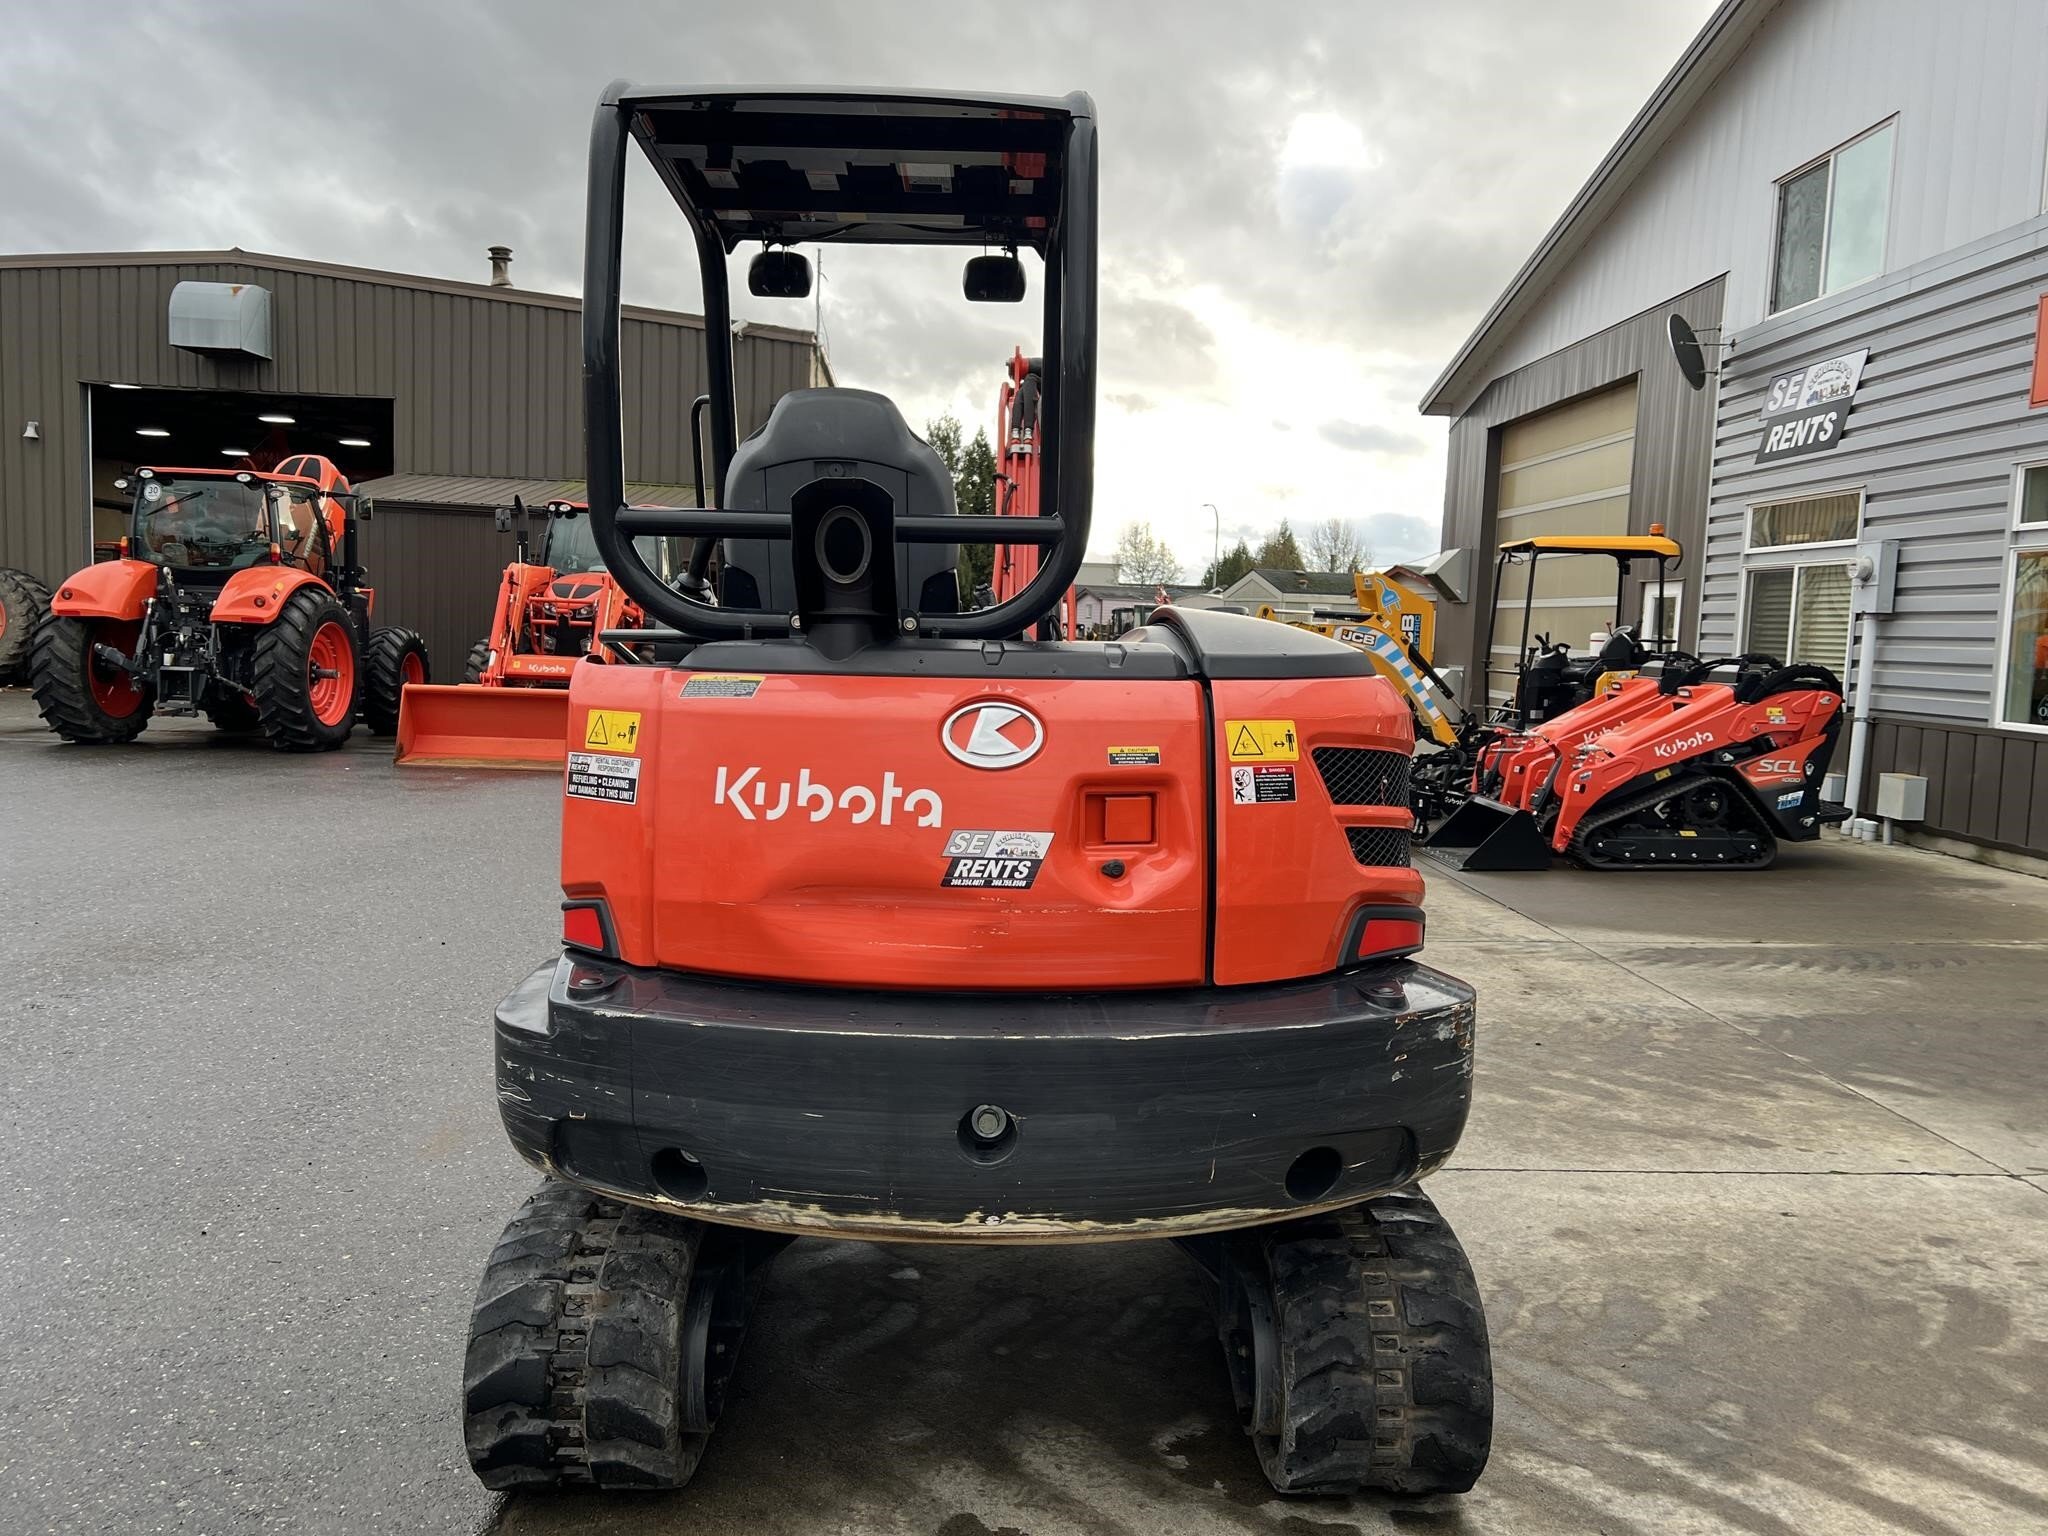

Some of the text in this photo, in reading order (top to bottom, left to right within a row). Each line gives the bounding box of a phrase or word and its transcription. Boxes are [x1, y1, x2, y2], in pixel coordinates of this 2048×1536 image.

[1768, 373, 1805, 411] SE
[1764, 411, 1838, 453] RENTS
[1342, 629, 1376, 646] JCB
[529, 664, 566, 673] Kubota
[1654, 731, 1714, 757] Kubota
[1757, 759, 1801, 773] SCL
[572, 774, 630, 789] REFUELING CLEANING
[568, 784, 634, 800] ANY DAMAGE TO THIS UNIT
[714, 766, 943, 828] Kubota
[949, 832, 989, 854] SE
[953, 859, 1032, 879] RENTS
